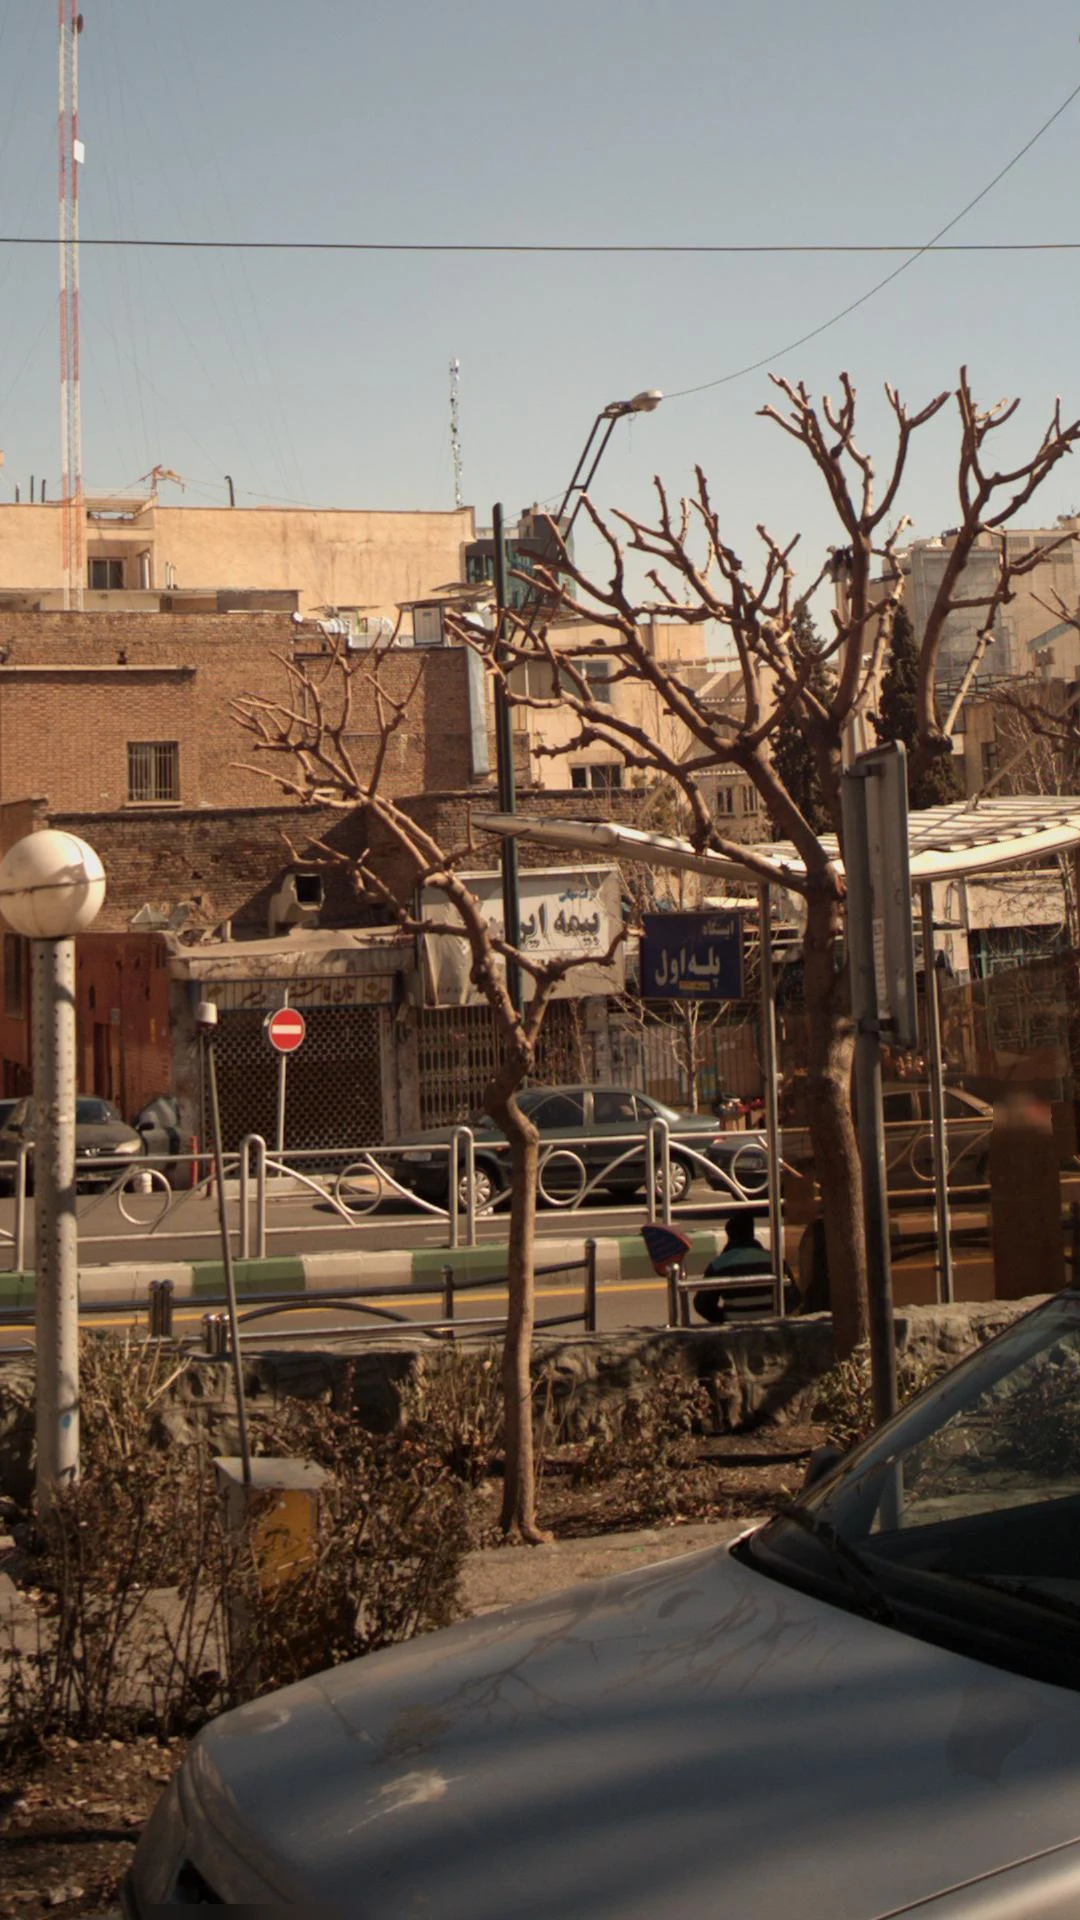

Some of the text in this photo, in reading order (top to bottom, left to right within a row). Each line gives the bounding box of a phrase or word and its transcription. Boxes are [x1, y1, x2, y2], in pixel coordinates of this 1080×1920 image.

[554, 908, 600, 946] بیمه
[702, 917, 734, 940] ایستگاه
[655, 946, 686, 986] اول
